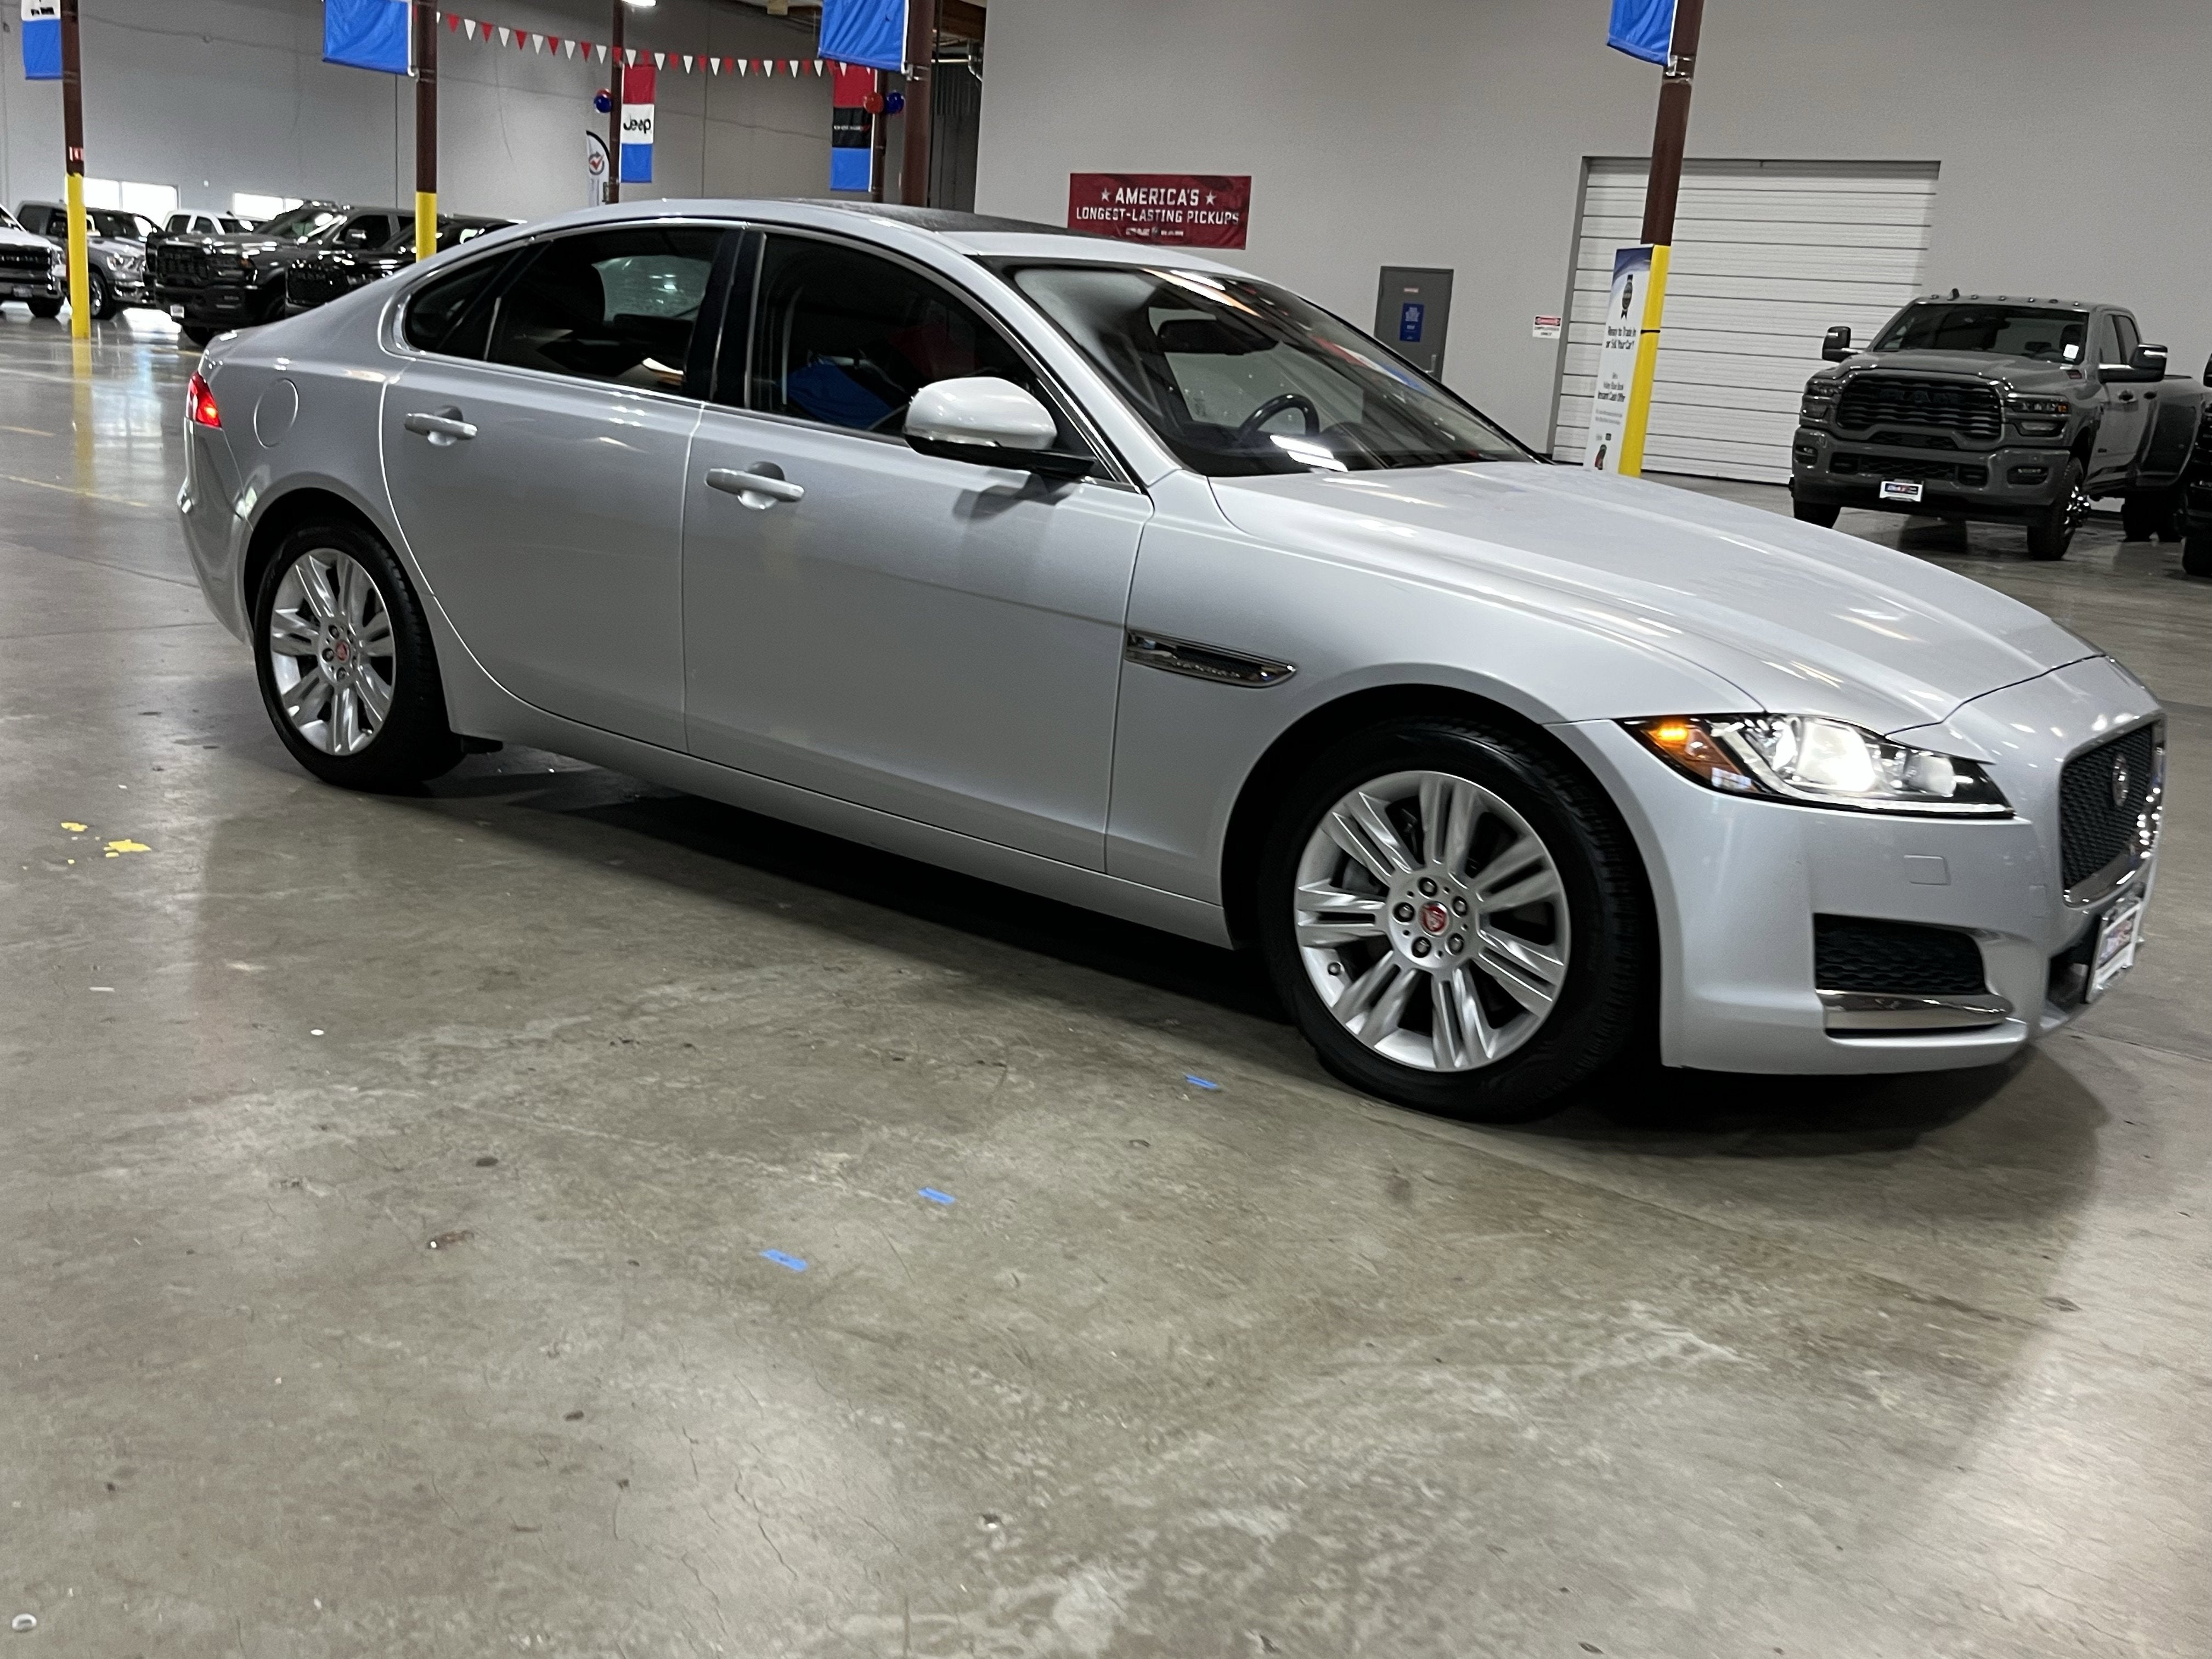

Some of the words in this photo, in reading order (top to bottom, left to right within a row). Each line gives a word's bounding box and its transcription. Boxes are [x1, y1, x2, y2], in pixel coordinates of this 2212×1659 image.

[623, 115, 651, 134] Jeep
[1115, 187, 1200, 206] AMERICA'S
[1076, 207, 1183, 223] LONGEST-LASTING
[1187, 210, 1239, 225] PICKUPS
